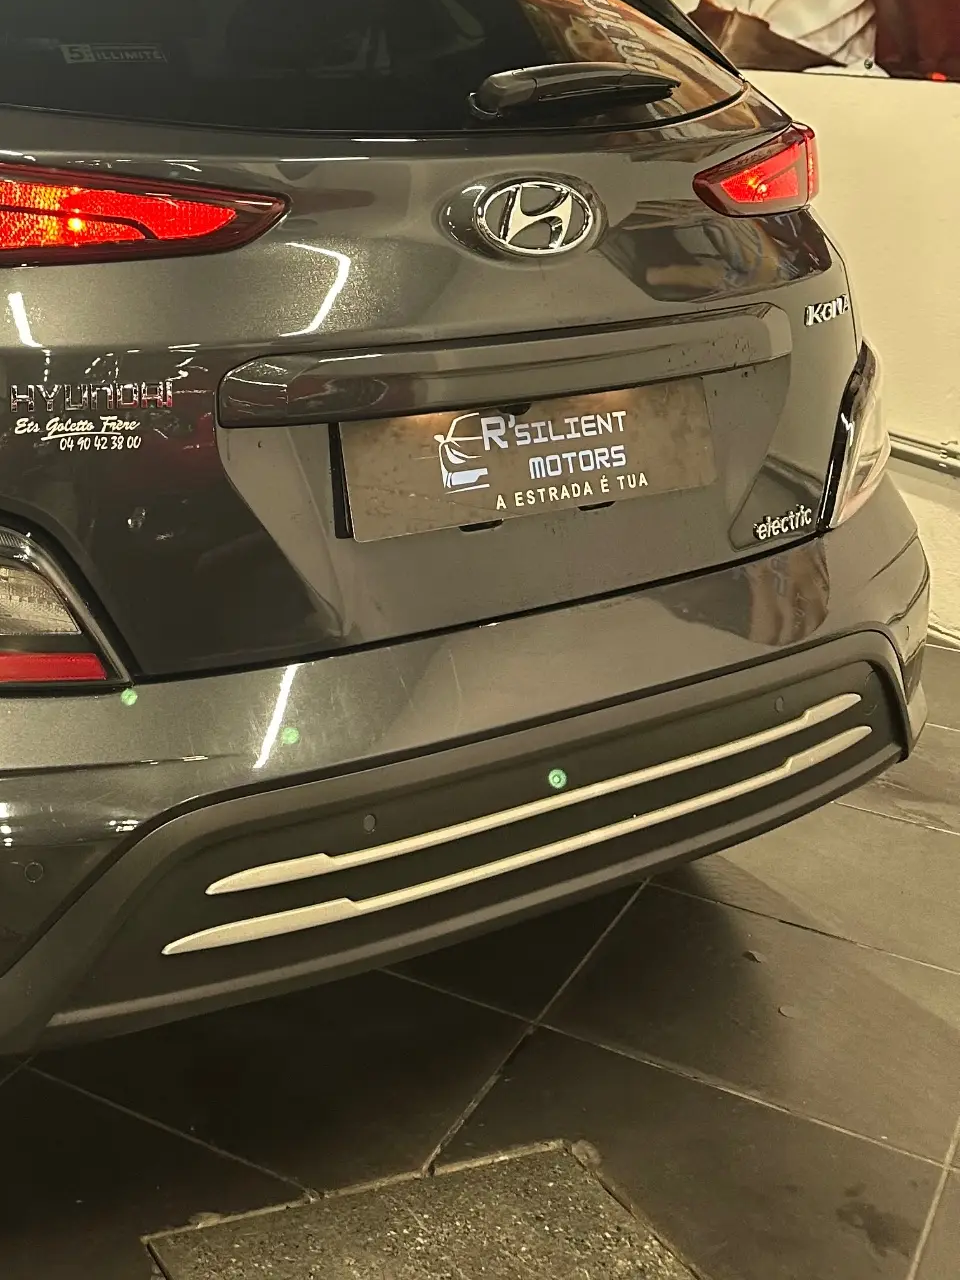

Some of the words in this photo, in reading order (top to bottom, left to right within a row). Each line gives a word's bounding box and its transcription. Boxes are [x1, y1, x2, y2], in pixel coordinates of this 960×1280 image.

[9, 382, 174, 413] HYUNDAI
[14, 417, 40, 435] Ets
[59, 437, 75, 451] 04
[76, 436, 91, 451] 90
[93, 436, 108, 451] 42
[110, 435, 124, 450] 38
[528, 444, 627, 480] MOTORS
[495, 493, 507, 511] A
[514, 483, 594, 508] ESTRADA
[600, 476, 611, 494] É
[616, 471, 649, 492] TUA
[753, 503, 812, 540] electric
